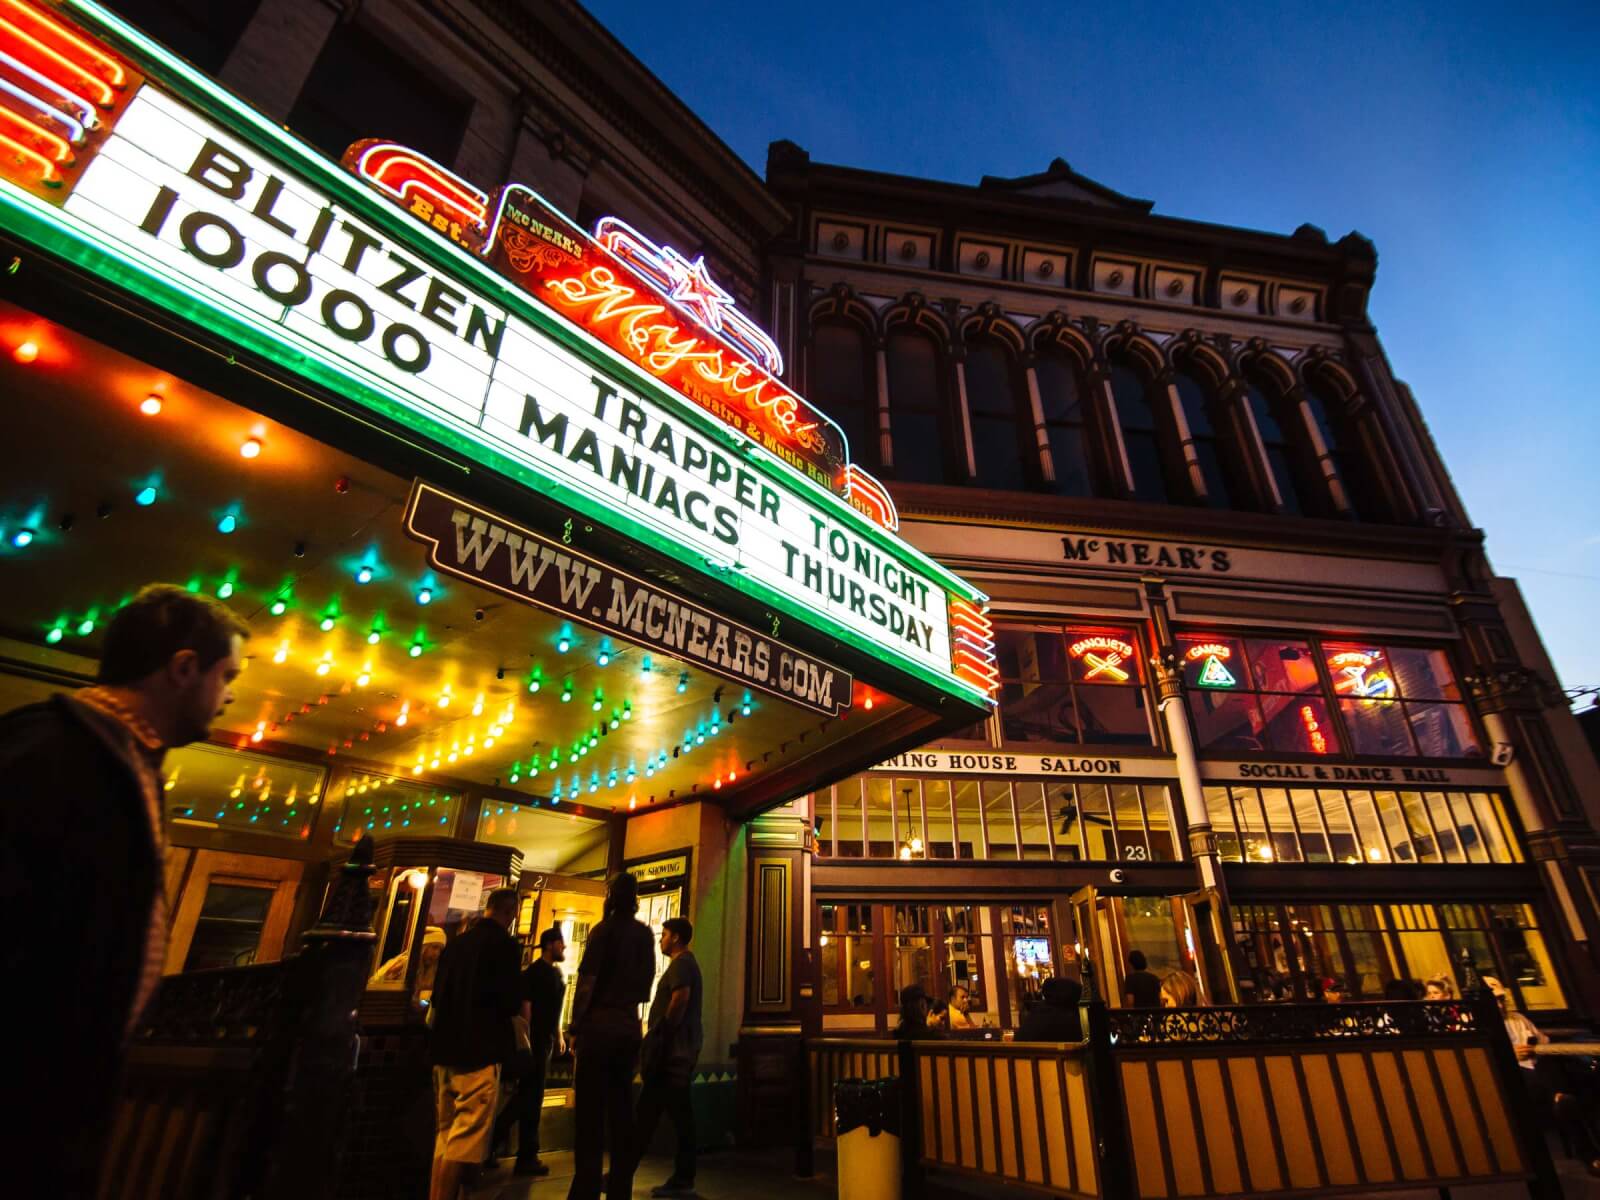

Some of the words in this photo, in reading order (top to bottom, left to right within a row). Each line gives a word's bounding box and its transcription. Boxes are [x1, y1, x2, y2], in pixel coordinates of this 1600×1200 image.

[410, 193, 469, 248] Est.
[546, 266, 801, 434] Mystic
[186, 138, 505, 360] BLITZEN
[591, 376, 780, 526] TRAPPER
[810, 514, 930, 613] TONIGHT
[681, 376, 742, 429] Theatre
[746, 421, 761, 443] &
[763, 432, 804, 471] Music
[807, 462, 833, 491] Hall
[518, 394, 740, 547] MANIACS
[781, 540, 934, 653] THURSDAY
[452, 509, 834, 708] WWW.MCNEARS.COM
[1071, 637, 1133, 656] BANQUETS
[1190, 644, 1231, 657] GAMES
[949, 755, 1018, 770] HOUSE
[1041, 758, 1122, 774] SALOON
[1239, 763, 1309, 779] SOCIAL
[1314, 767, 1329, 780] &
[1335, 767, 1394, 782] DANCE
[1403, 769, 1451, 783] HALL
[648, 862, 680, 876] SHOWING
[1125, 845, 1146, 861] 23
